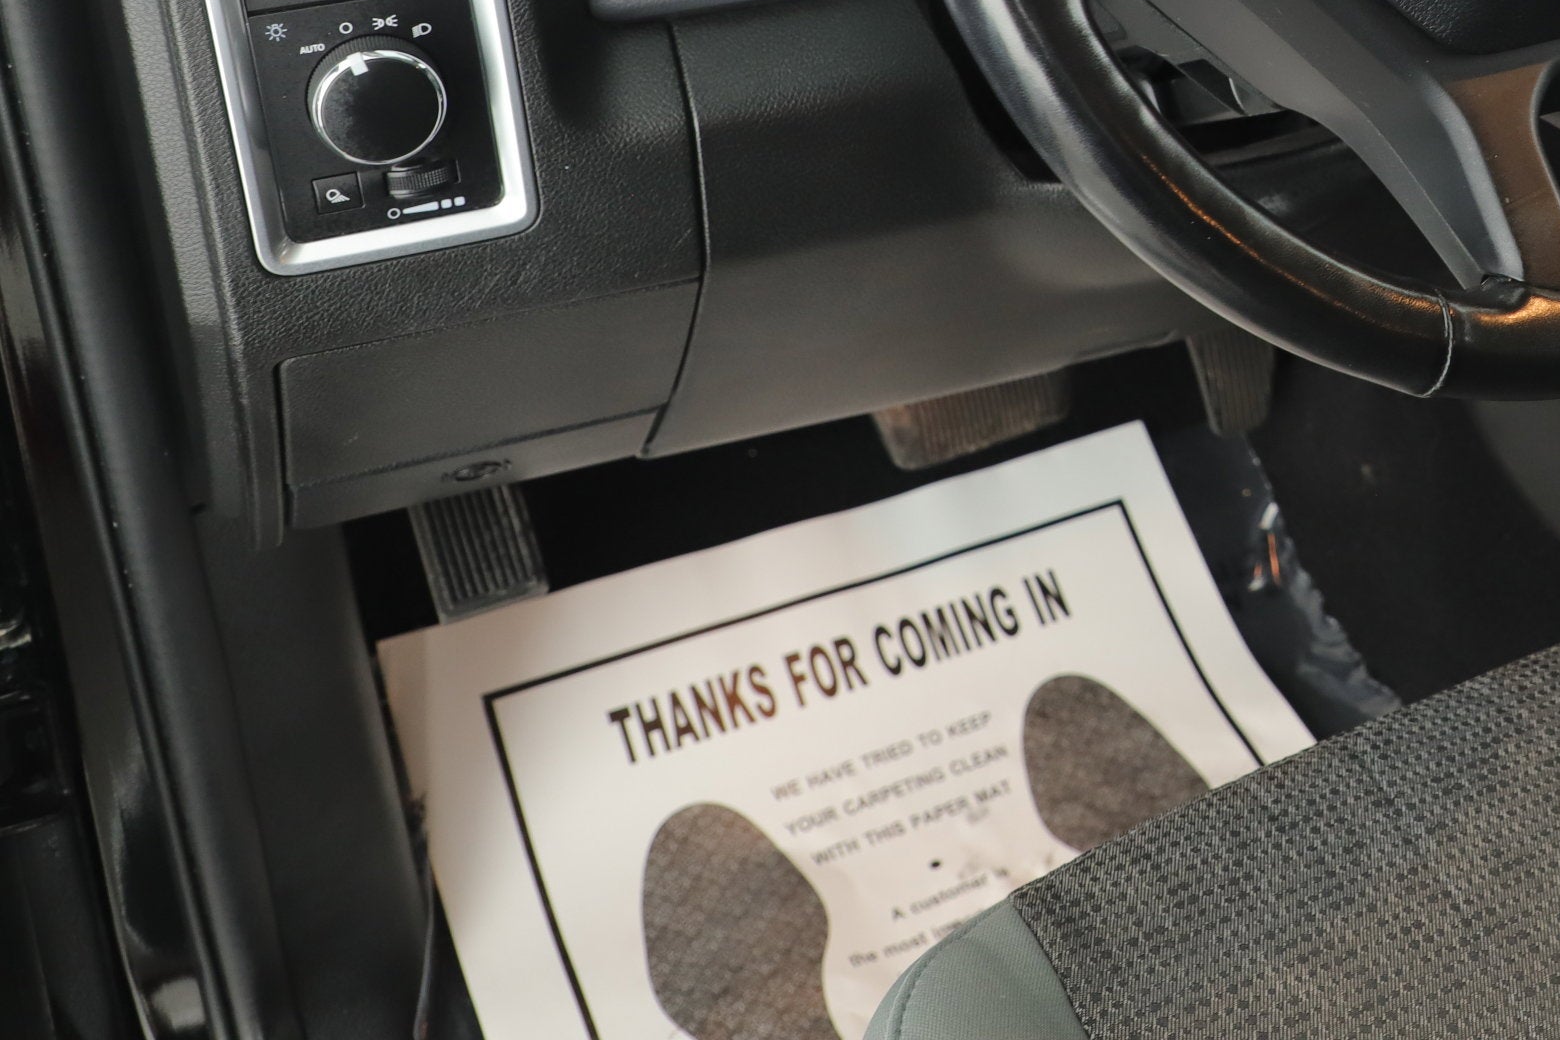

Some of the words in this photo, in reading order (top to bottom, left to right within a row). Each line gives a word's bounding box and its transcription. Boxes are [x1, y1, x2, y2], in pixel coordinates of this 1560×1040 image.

[299, 42, 326, 56] AUTO
[608, 661, 779, 765] THANKS
[784, 635, 869, 708] FOR
[873, 586, 1020, 677] COMING
[1022, 568, 1072, 627] IN
[771, 779, 801, 801] WE
[805, 761, 855, 789] HAVE
[862, 739, 914, 769] TRIED
[915, 728, 943, 749] TO
[946, 710, 992, 739] KEEP
[784, 806, 839, 836] YOUR
[843, 766, 946, 816] CARPETING
[949, 745, 1010, 776] CLEAN
[811, 838, 861, 866] WITH
[864, 820, 907, 848] THIS
[909, 795, 970, 829] PAPER
[973, 778, 1011, 804] MAT
[891, 906, 906, 922] A
[909, 873, 989, 914] customer
[848, 950, 879, 968] the
[883, 931, 928, 959] most
